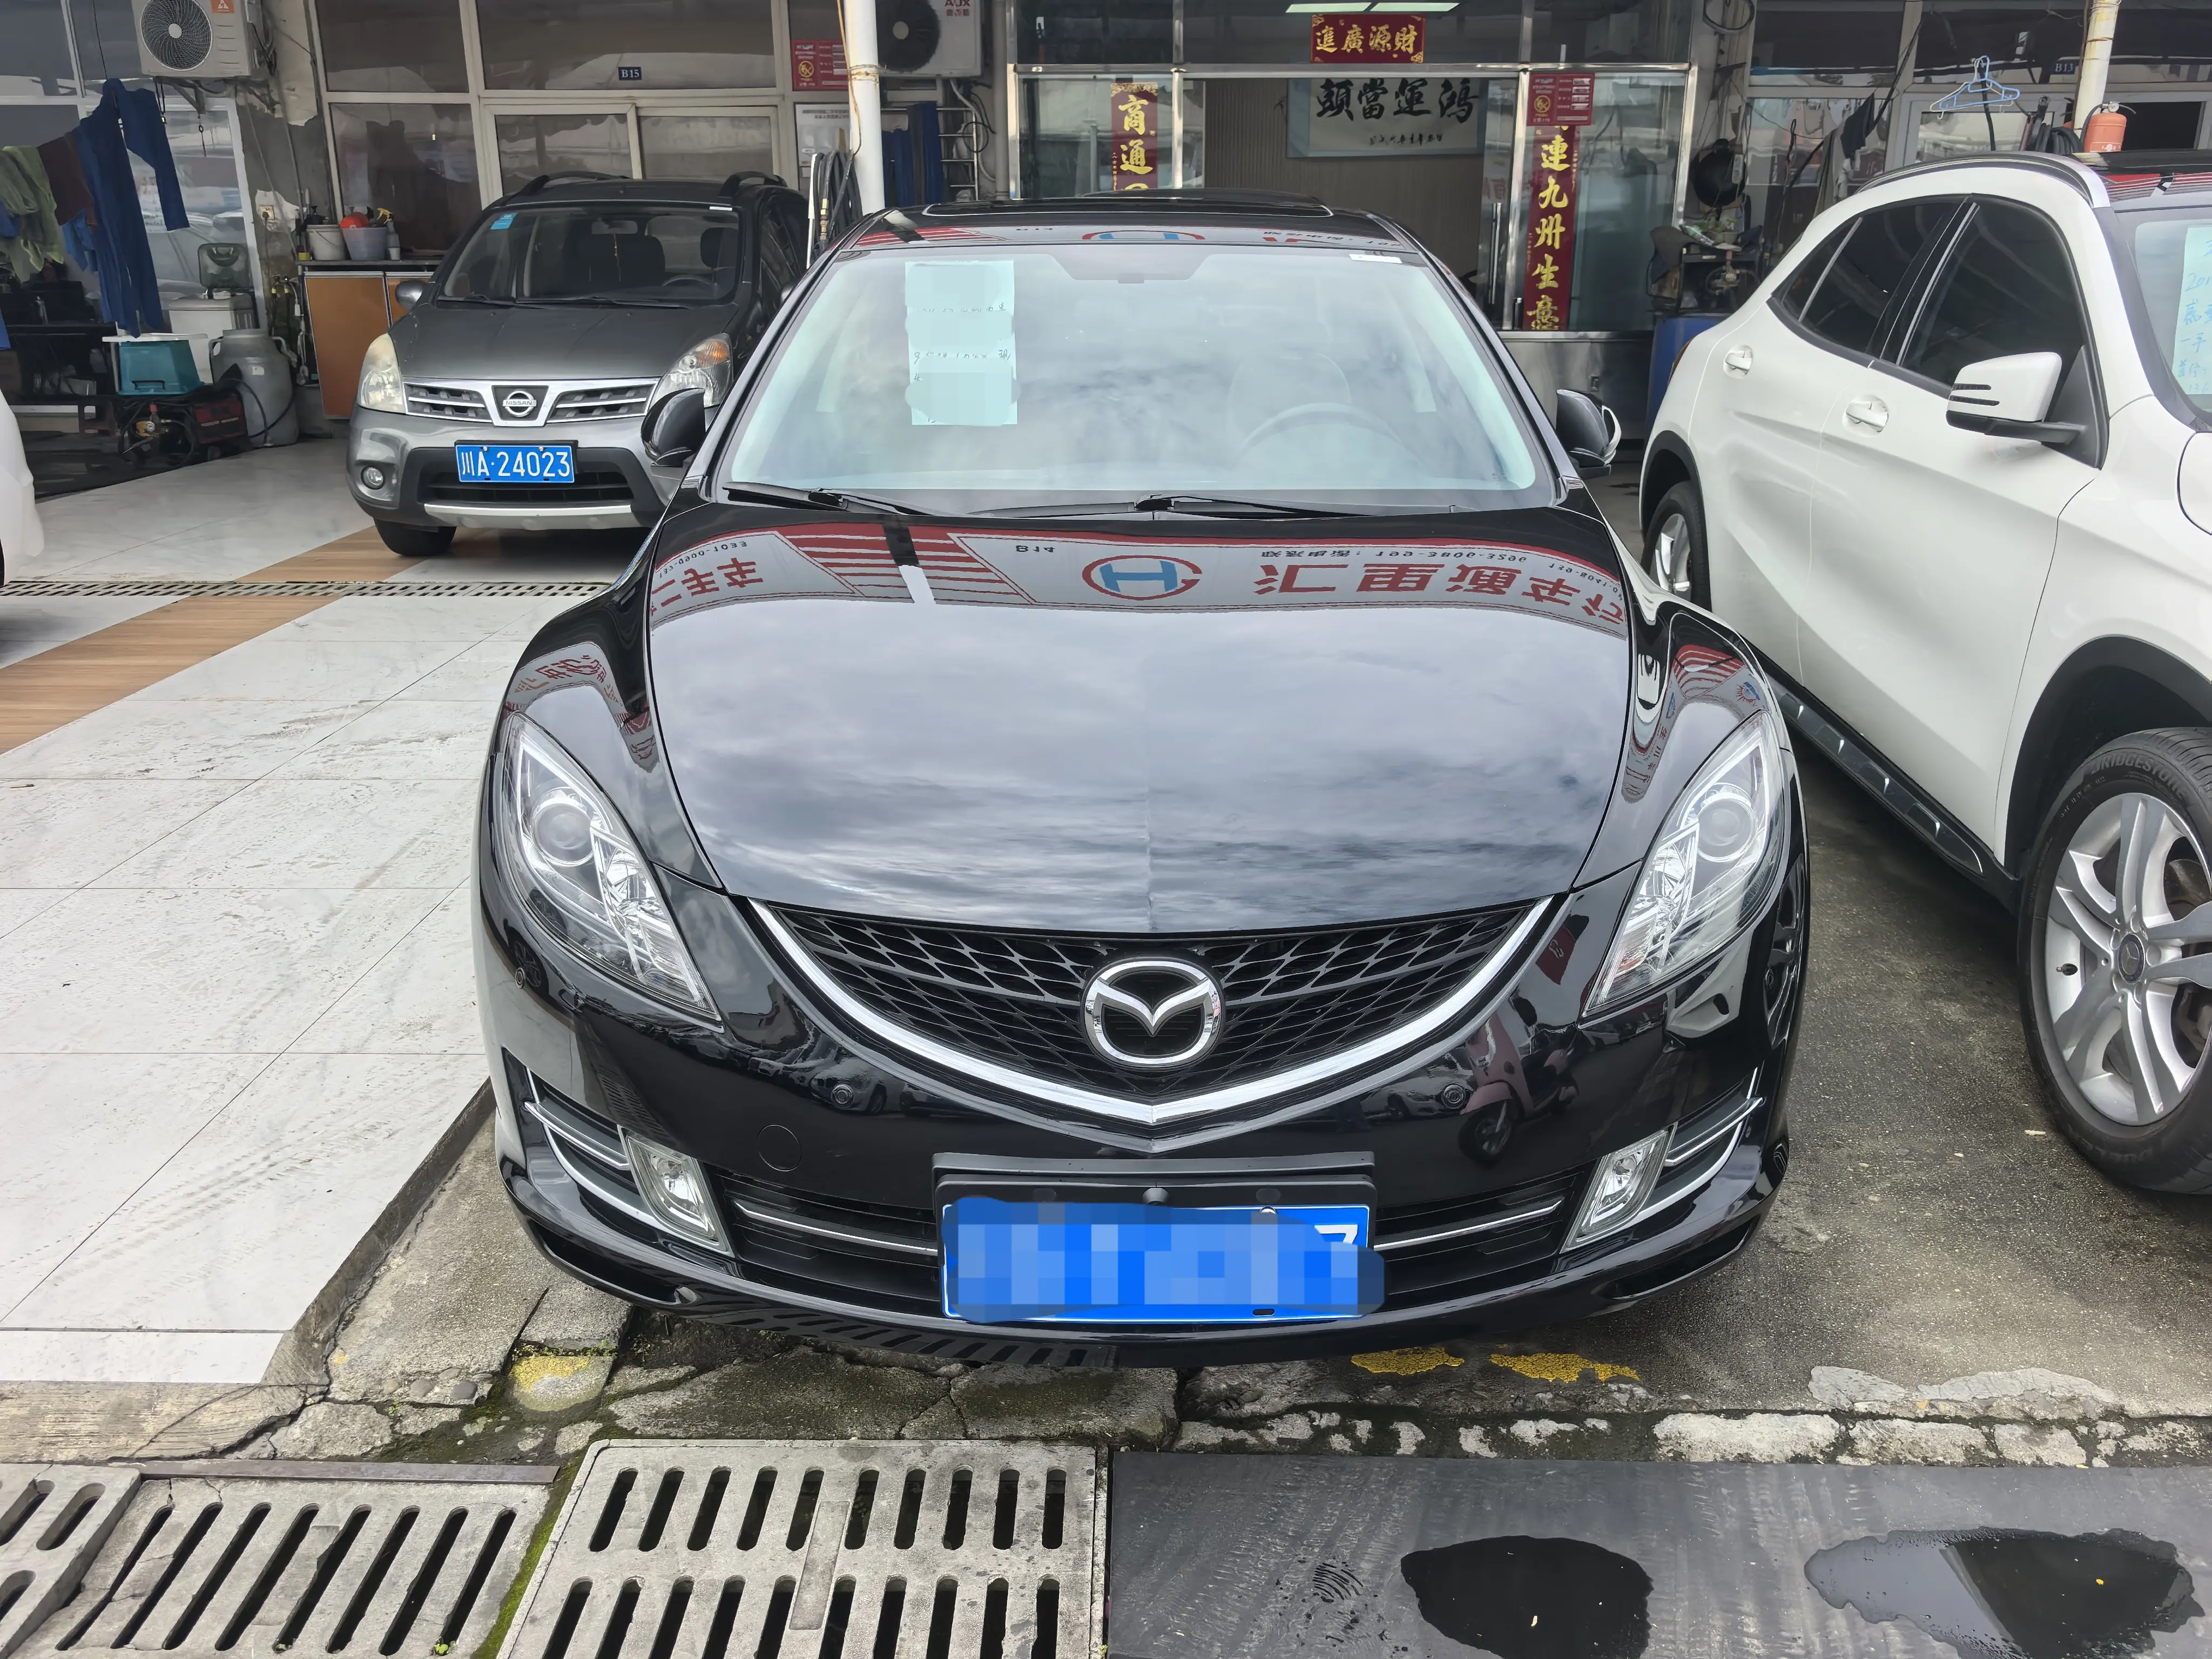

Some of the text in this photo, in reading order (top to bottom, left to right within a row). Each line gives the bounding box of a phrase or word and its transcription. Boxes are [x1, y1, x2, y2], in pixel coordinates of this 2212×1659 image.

[2055, 63, 2073, 72] B13
[622, 69, 639, 78] B15
[1118, 95, 1152, 190] 商通
